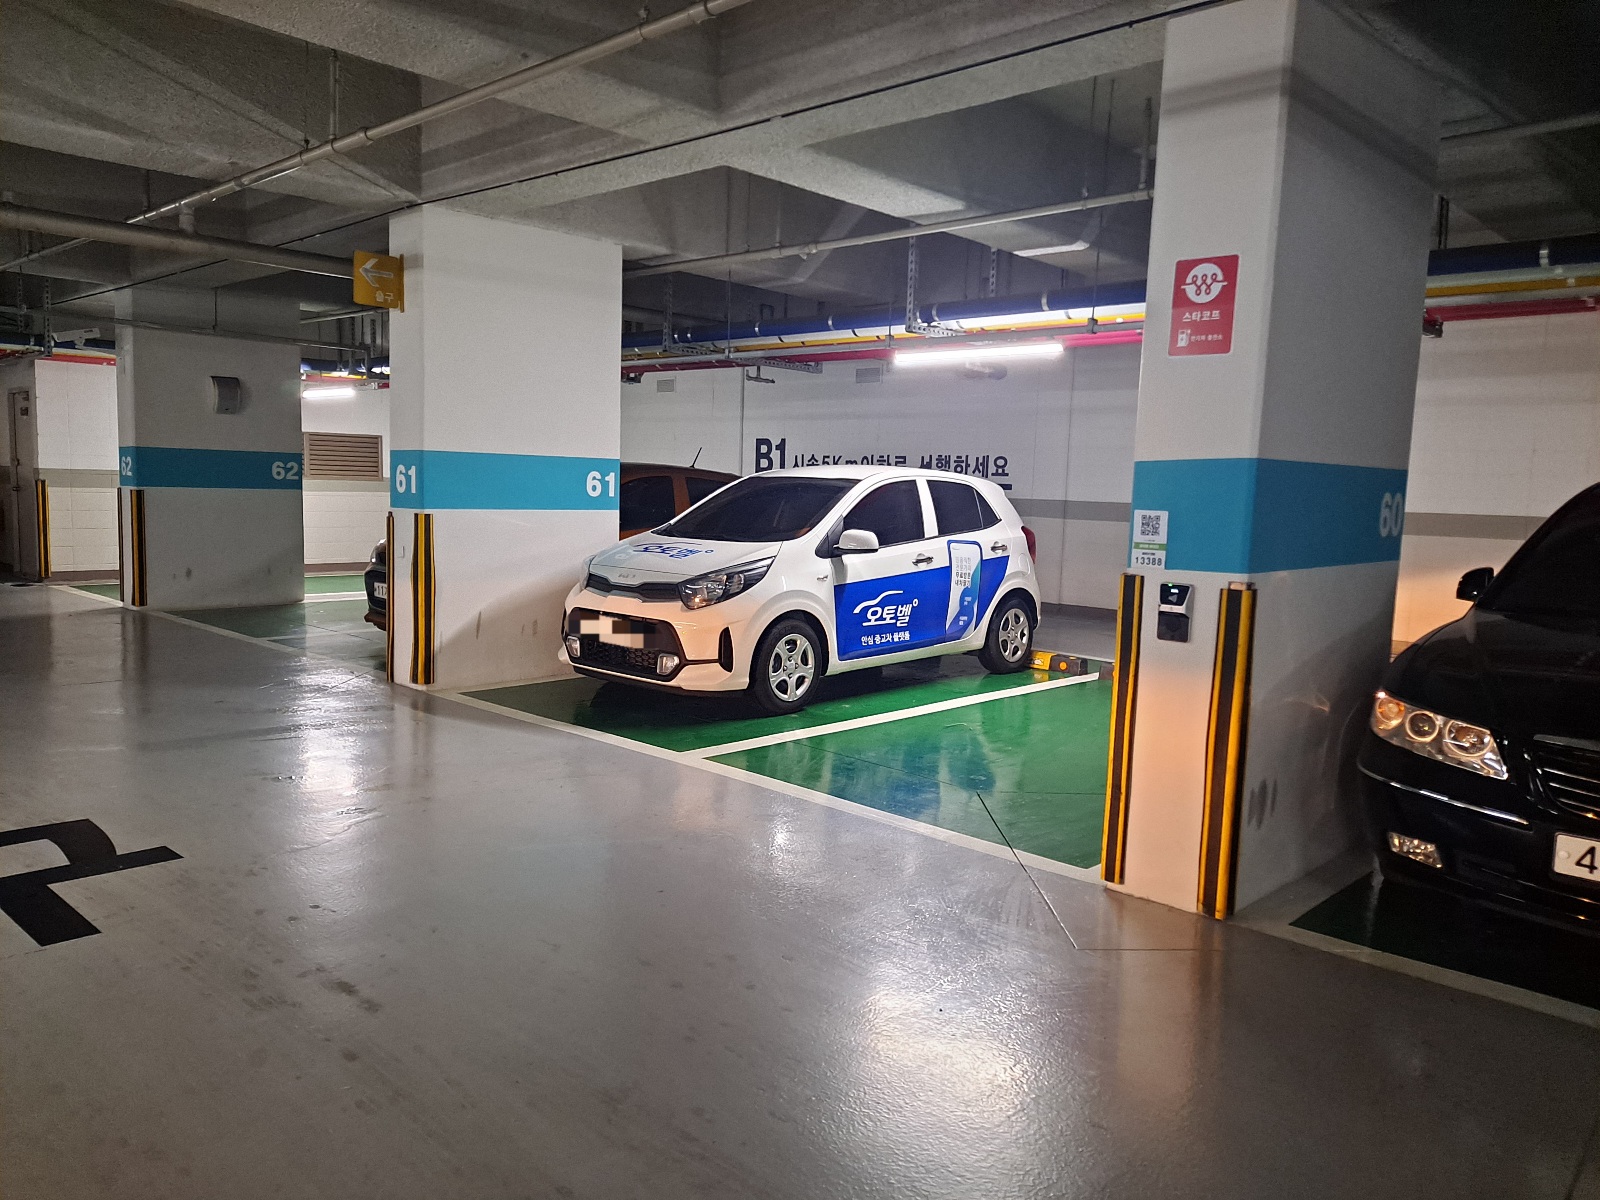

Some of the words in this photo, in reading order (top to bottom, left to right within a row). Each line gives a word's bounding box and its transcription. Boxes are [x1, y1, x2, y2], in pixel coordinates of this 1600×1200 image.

[1183, 310, 1220, 322] 스타코프
[121, 456, 132, 476] 62
[755, 438, 787, 473] B1
[920, 454, 1009, 478] 서행하세요
[271, 461, 299, 480] 62
[395, 464, 416, 494] 61
[586, 470, 616, 497] 61
[1380, 492, 1404, 537] 60
[1135, 556, 1162, 566] 13388
[861, 635, 874, 646] 안심
[874, 632, 892, 645] 중고차
[893, 630, 910, 642] 플랫폼
